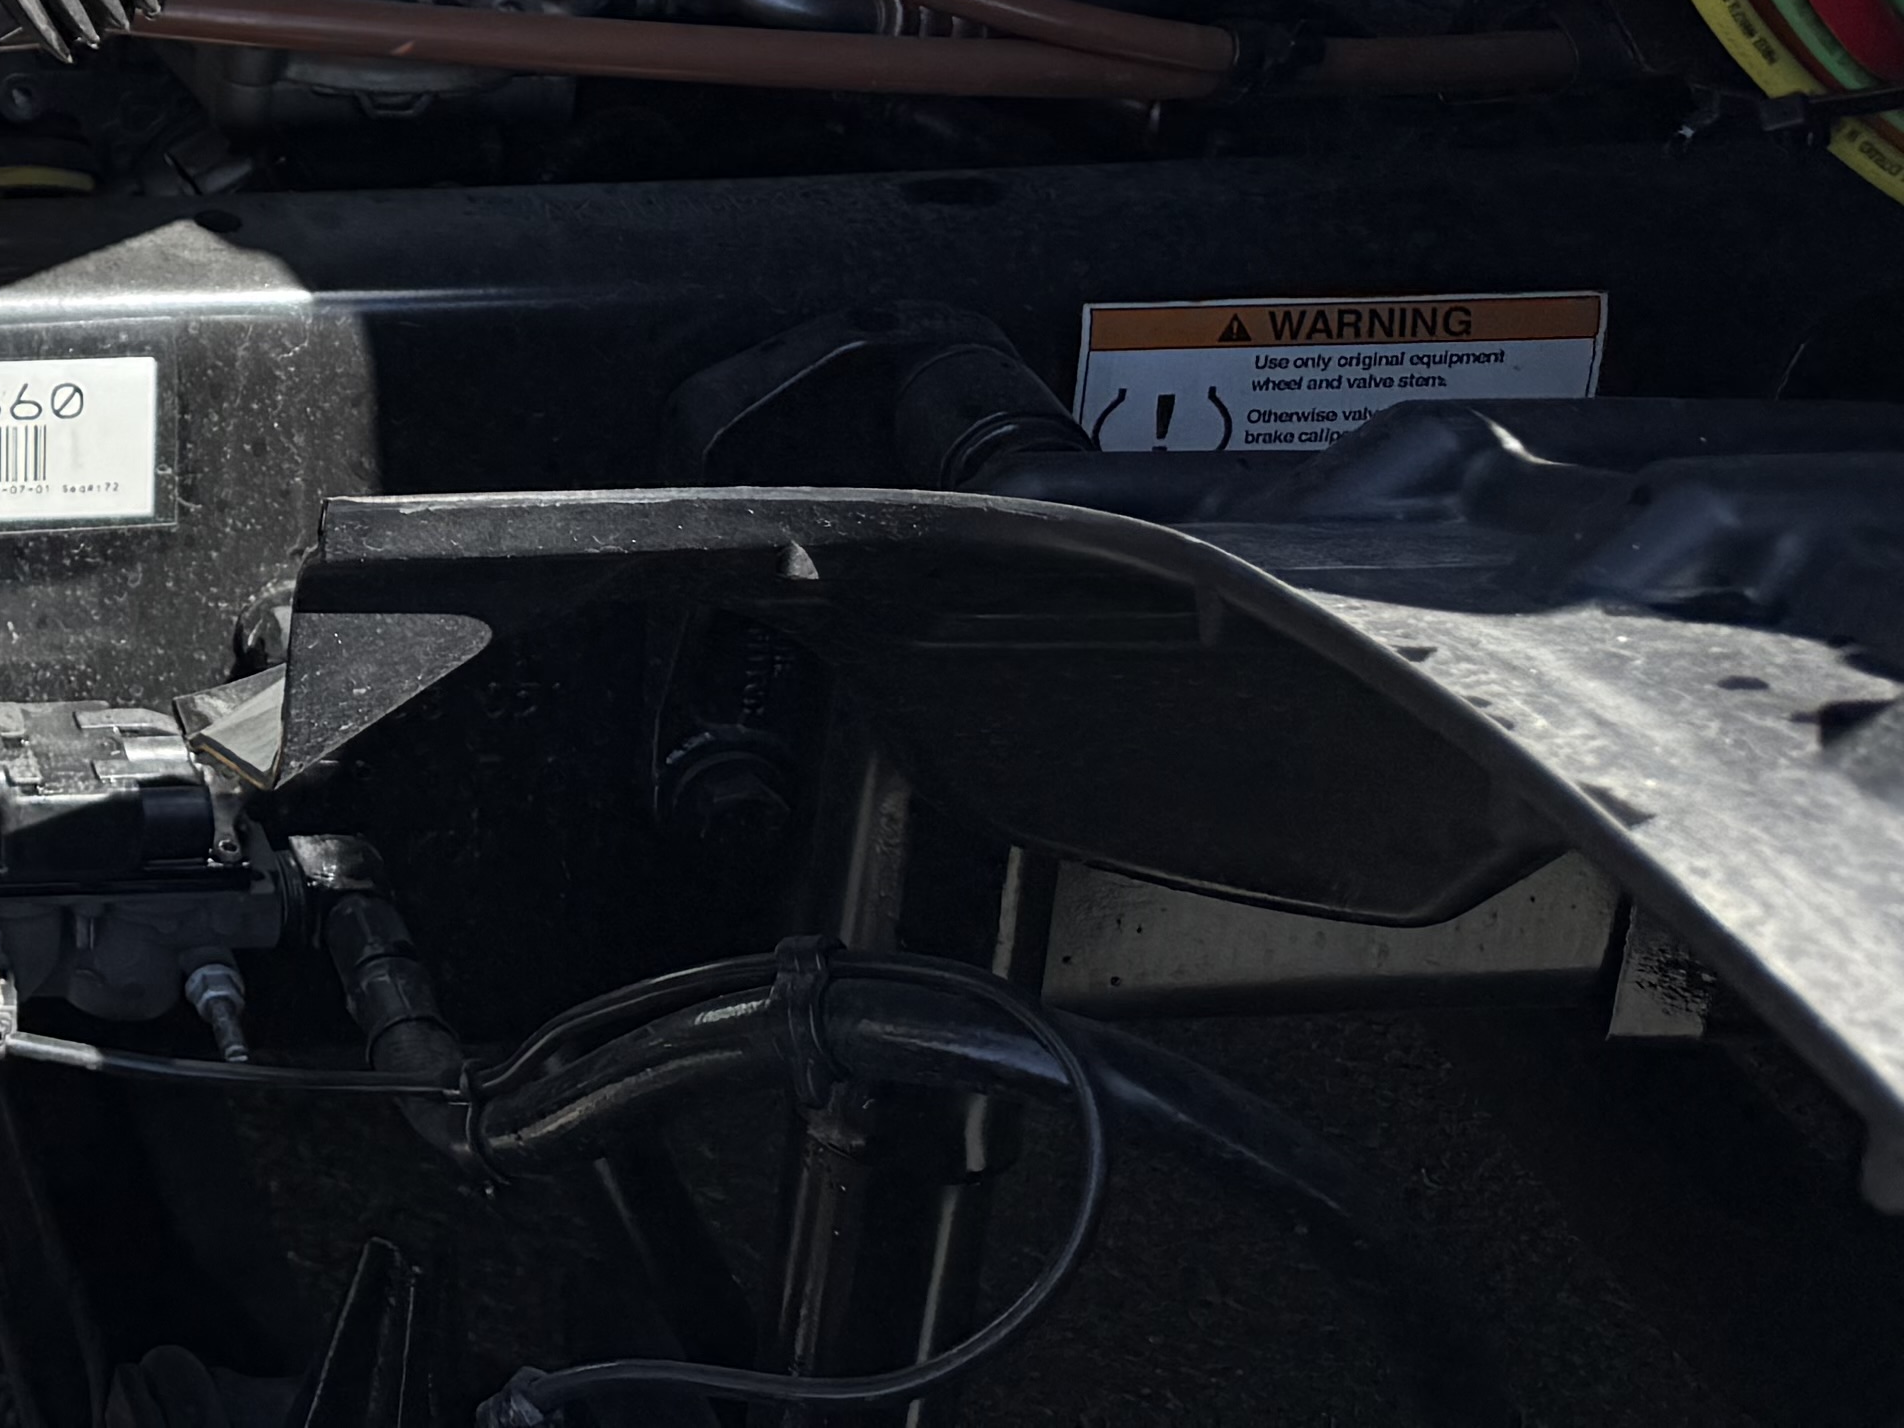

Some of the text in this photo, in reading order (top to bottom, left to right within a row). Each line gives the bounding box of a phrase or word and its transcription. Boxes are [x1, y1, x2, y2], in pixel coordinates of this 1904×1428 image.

[1268, 306, 1472, 342] WARNING
[1255, 348, 1506, 372] Use only original equipment
[1252, 374, 1395, 392] wheel and valve
[1246, 407, 1379, 424] Otherwise valv
[1244, 428, 1292, 445] brake
